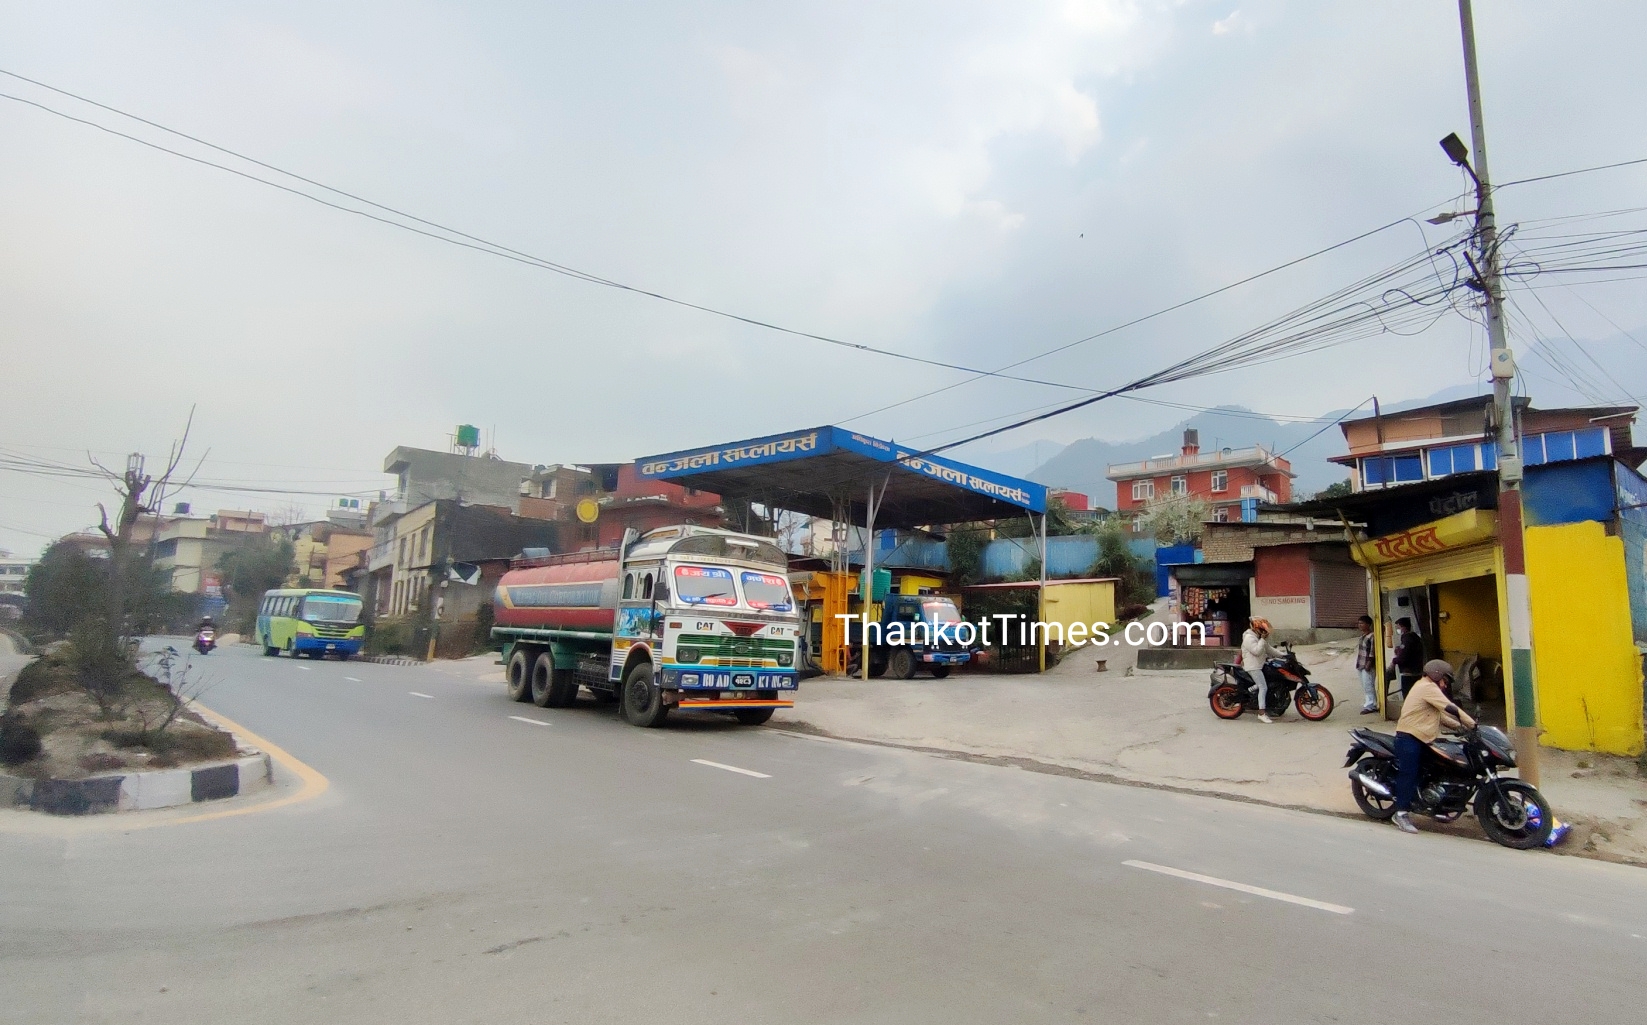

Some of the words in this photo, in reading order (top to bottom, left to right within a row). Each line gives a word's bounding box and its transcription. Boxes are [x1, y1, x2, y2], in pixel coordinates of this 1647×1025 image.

[722, 432, 818, 463] सप्लायर्स
[696, 621, 714, 631] CAT
[770, 626, 785, 635] CAT
